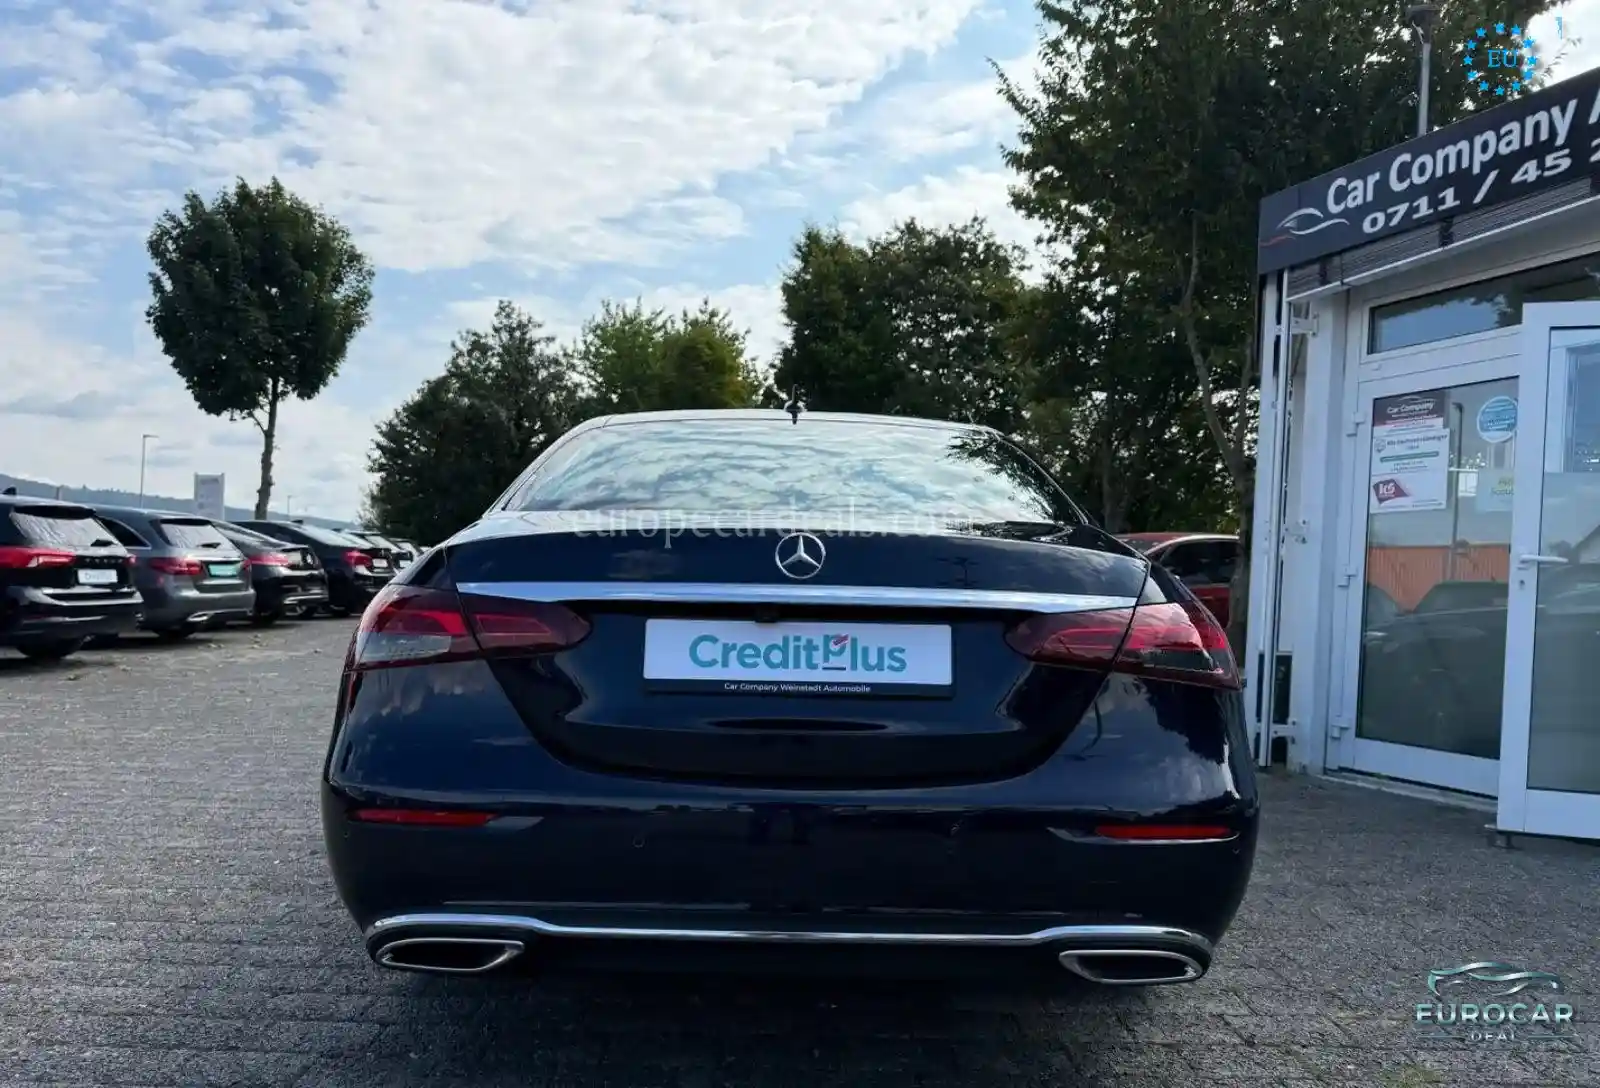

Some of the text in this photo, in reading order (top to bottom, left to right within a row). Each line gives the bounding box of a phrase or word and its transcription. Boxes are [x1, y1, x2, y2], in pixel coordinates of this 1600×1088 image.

[1326, 172, 1380, 214] Car
[1388, 99, 1578, 192] Company
[1362, 190, 1461, 234] 0711
[1511, 149, 1573, 184] 45
[689, 634, 907, 672] CreditPlus
[724, 682, 738, 691] Car
[740, 682, 779, 693] Company
[823, 684, 872, 693] Automobile
